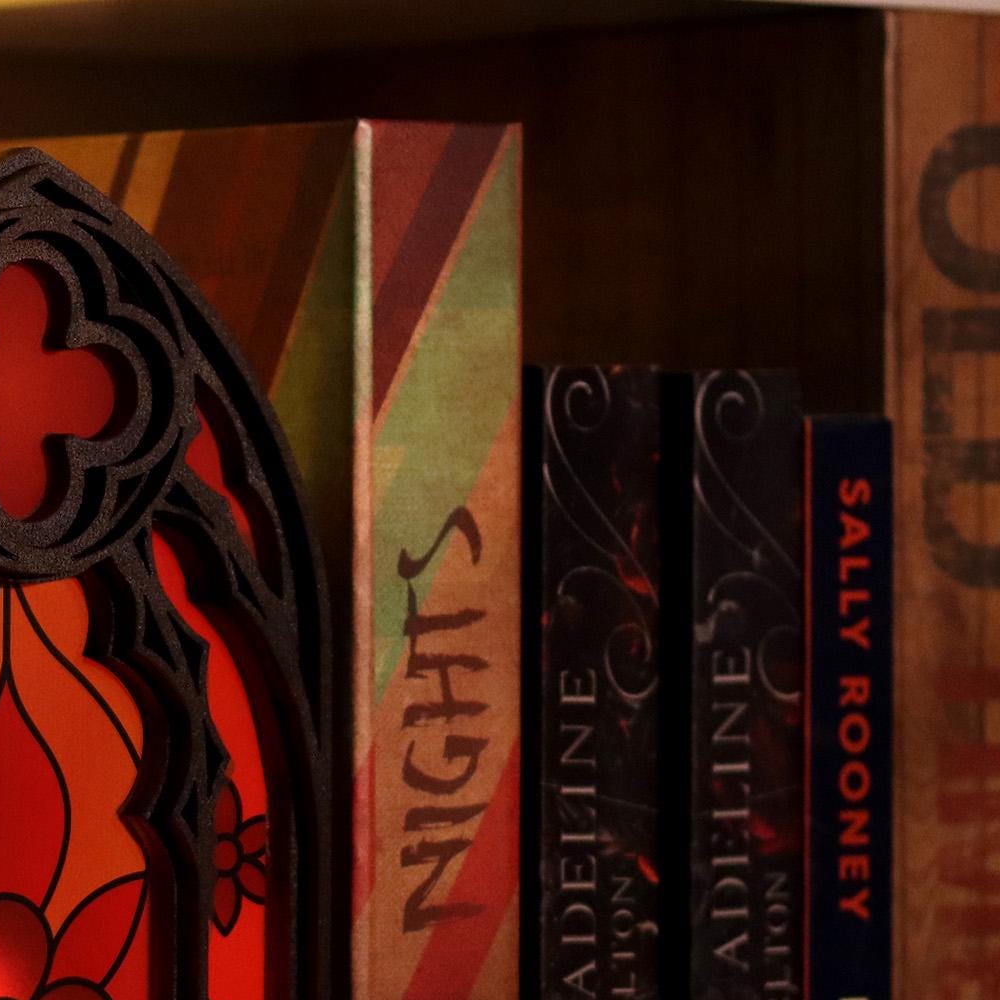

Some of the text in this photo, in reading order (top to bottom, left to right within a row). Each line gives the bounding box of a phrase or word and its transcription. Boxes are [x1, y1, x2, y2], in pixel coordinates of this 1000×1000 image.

[397, 505, 491, 933] NIGHTS
[837, 477, 872, 651] SALLY
[559, 667, 597, 1000] ADELINE
[711, 647, 751, 973] ADELINE
[837, 674, 872, 922] ROONEY
